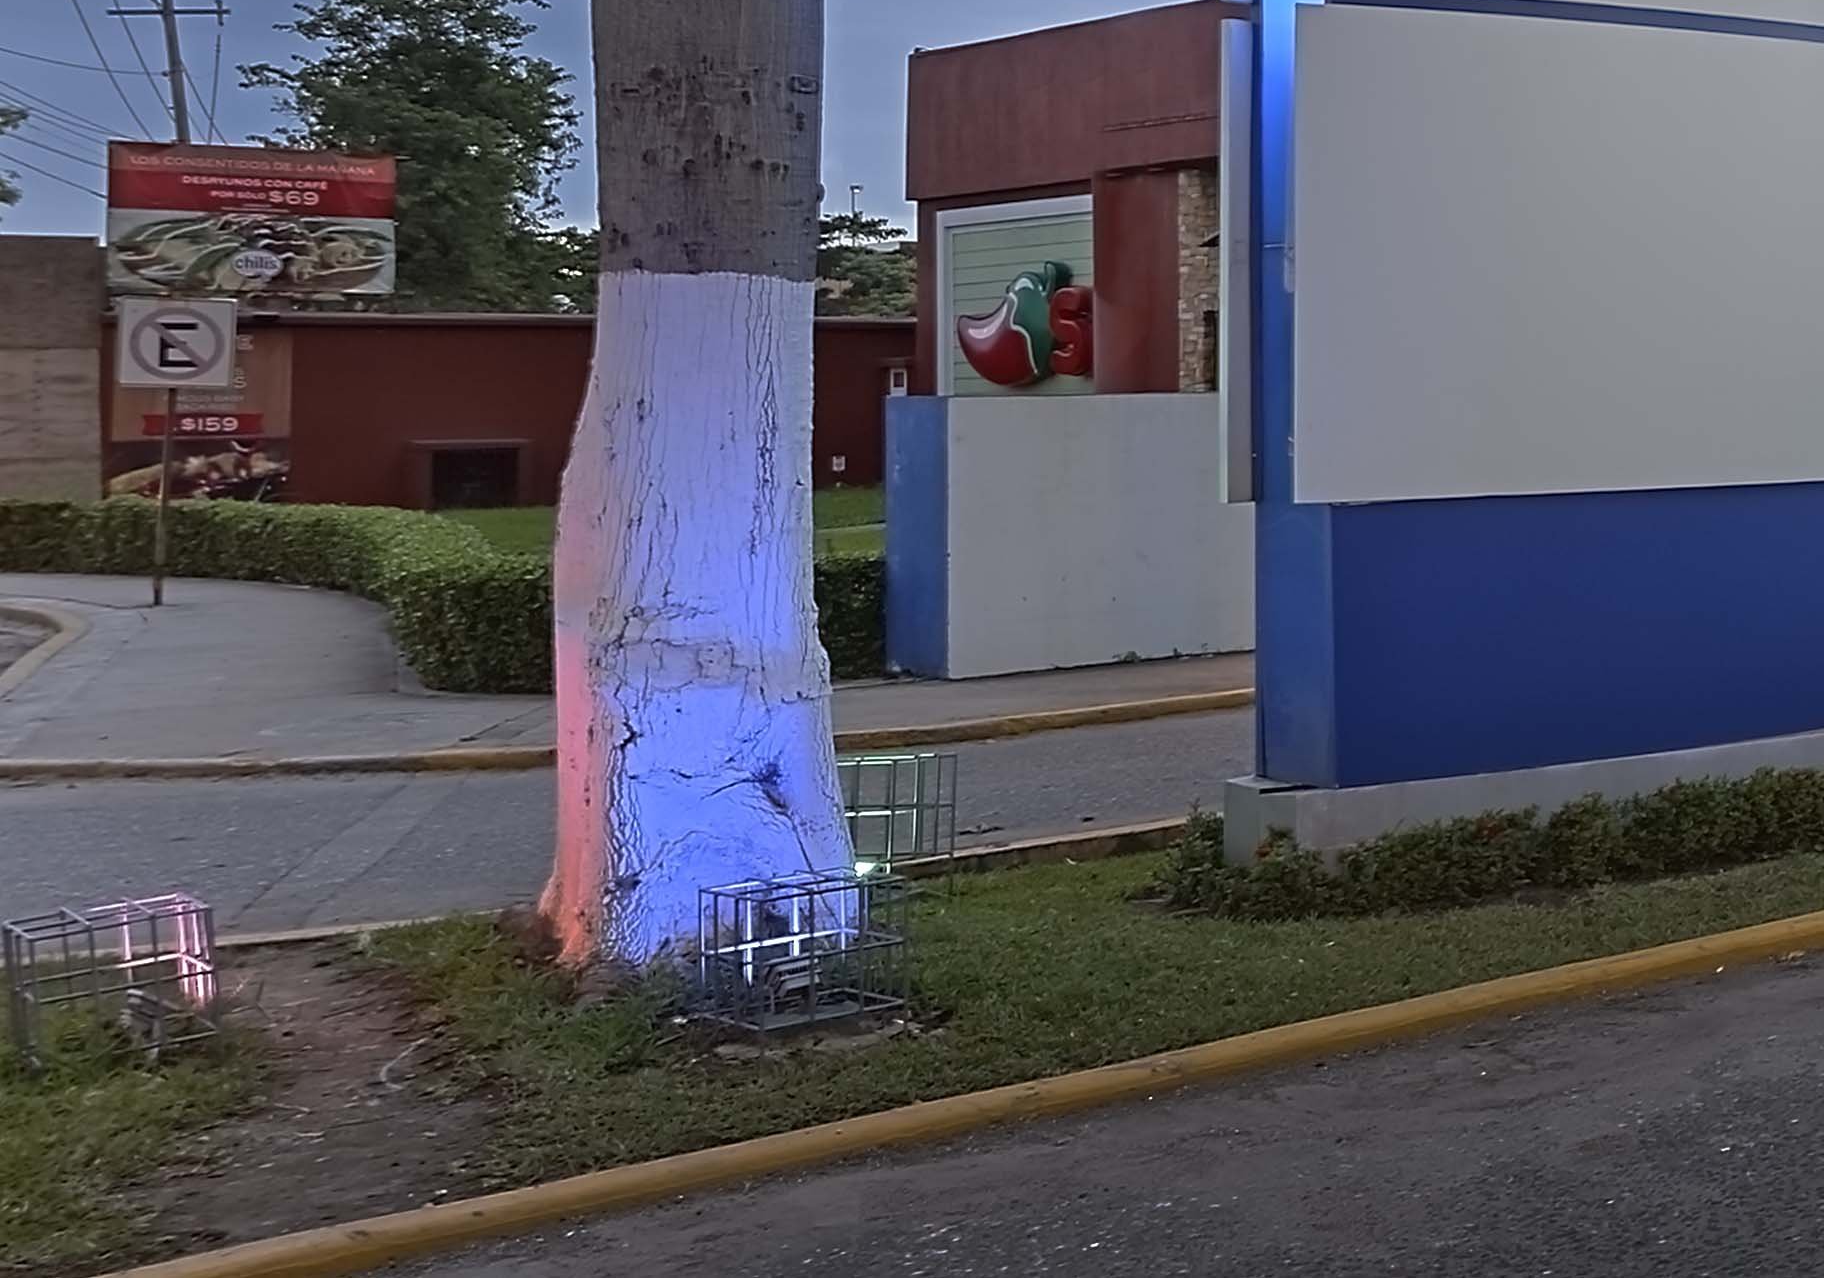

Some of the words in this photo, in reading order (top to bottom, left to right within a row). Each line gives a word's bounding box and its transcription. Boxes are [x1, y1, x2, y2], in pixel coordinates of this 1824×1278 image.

[298, 163, 314, 172] LA
[264, 179, 293, 188] CON
[268, 189, 320, 206] $69
[158, 322, 199, 368] E
[180, 416, 239, 433] $159
